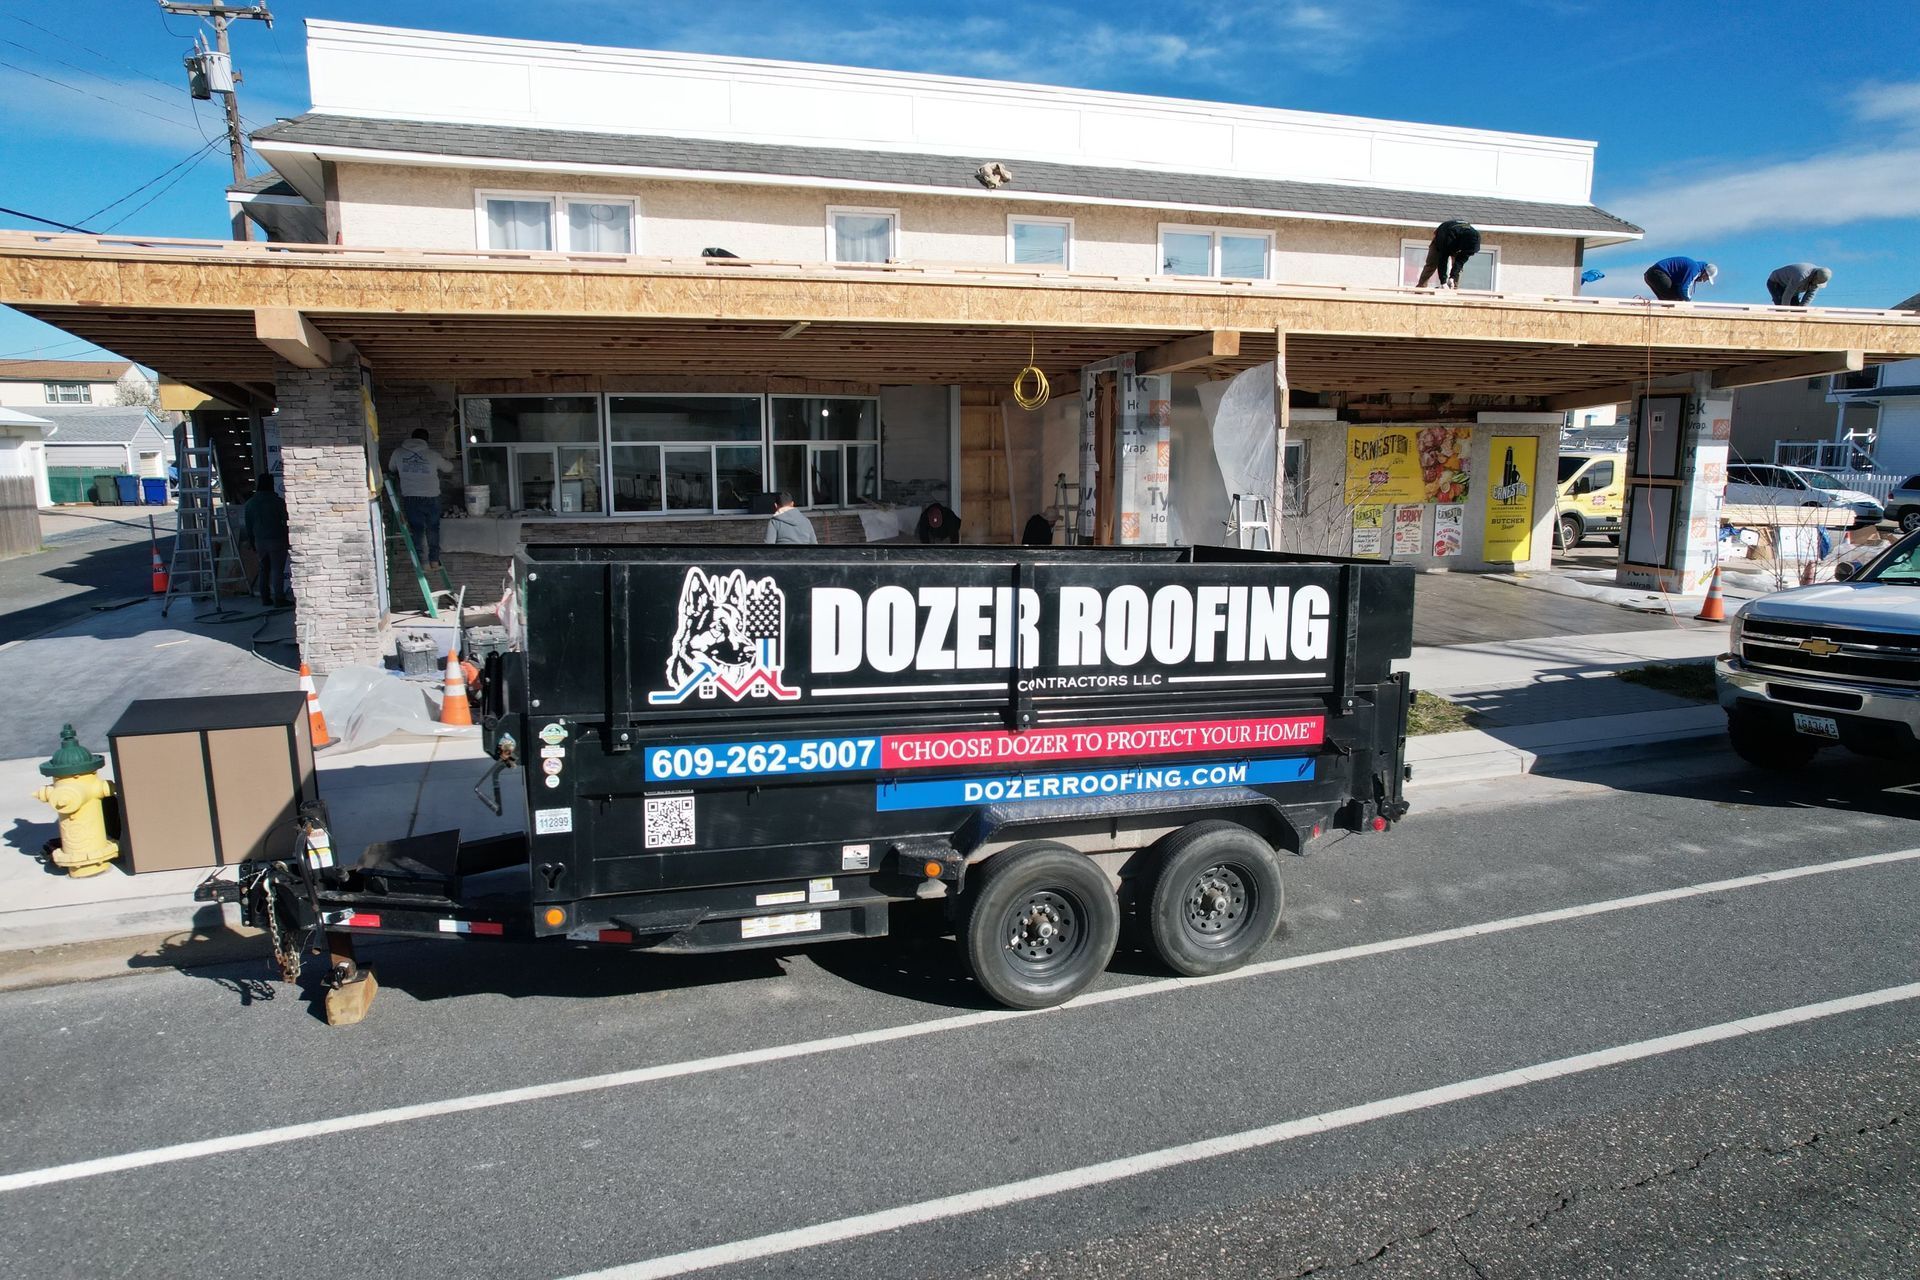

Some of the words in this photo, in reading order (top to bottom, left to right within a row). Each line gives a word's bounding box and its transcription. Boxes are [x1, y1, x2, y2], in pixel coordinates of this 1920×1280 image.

[1397, 510, 1423, 522] JERKY
[811, 586, 1041, 673] DOZER
[1057, 585, 1330, 666] ROOFING
[1017, 674, 1129, 692] CONTRACTORS
[1132, 674, 1162, 686] LLC
[652, 740, 876, 779] 609-262-5007
[890, 738, 993, 762] "CHOOSE
[997, 735, 1069, 757] DOZER
[1072, 732, 1103, 752] TO
[1107, 728, 1197, 751] PROTECT
[1200, 725, 1252, 745] YOUR
[1255, 722, 1316, 742] HOME"
[964, 766, 1247, 801] DOZERROOFING.COM
[539, 816, 569, 829] 112899
